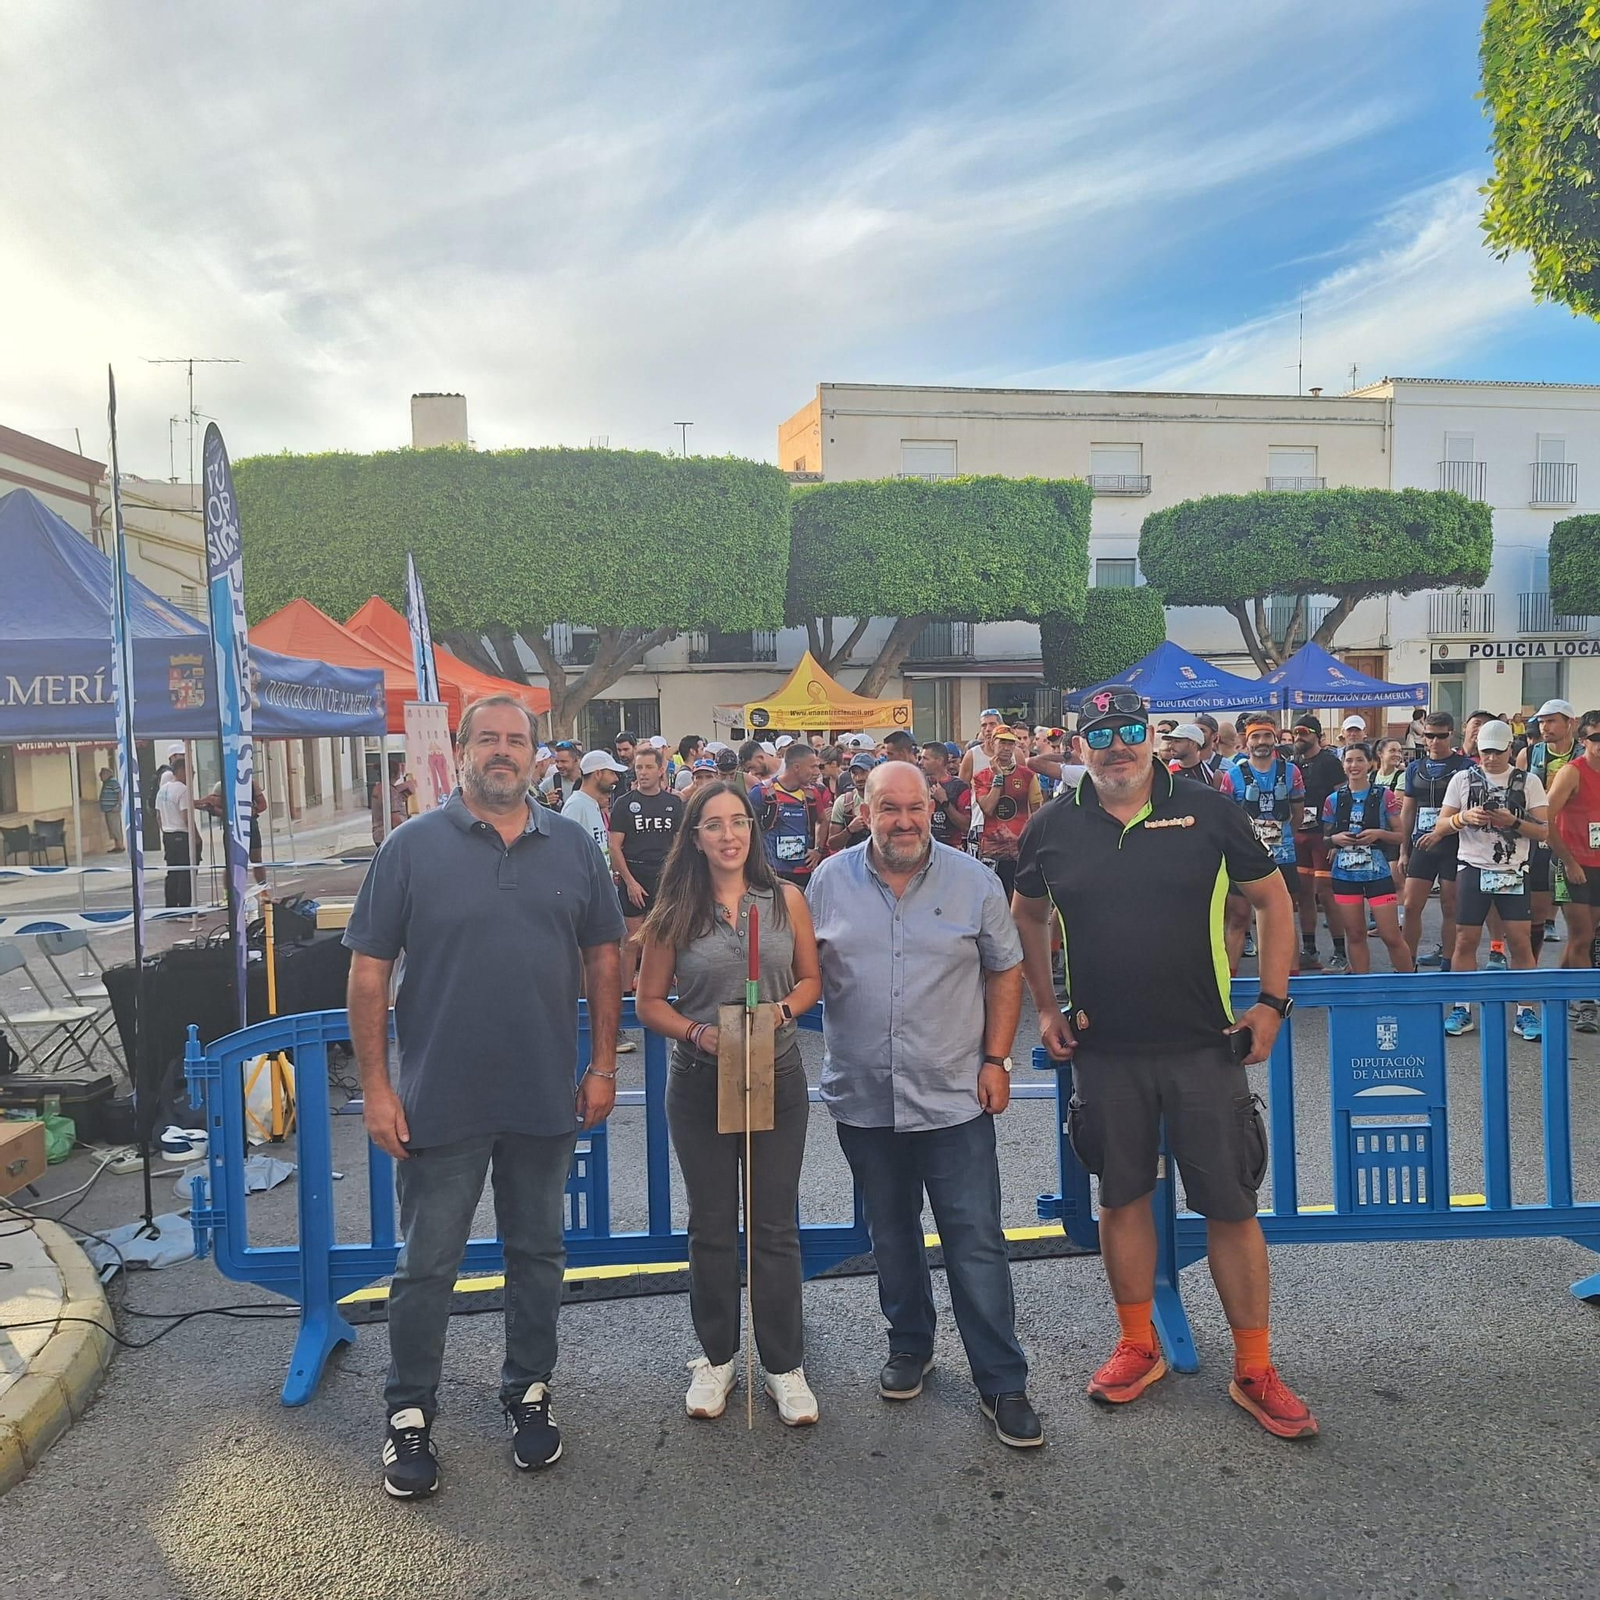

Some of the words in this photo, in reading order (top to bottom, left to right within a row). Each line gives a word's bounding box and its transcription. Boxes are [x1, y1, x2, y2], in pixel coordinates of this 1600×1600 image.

[1469, 642, 1547, 658] POLICIA
[0, 666, 137, 705] MERÍ
[265, 679, 327, 711] DIPUTACIÓN
[327, 688, 339, 713] DE
[1156, 695, 1210, 708] DIPUTACIÓN
[1213, 698, 1225, 706] DE
[1226, 694, 1264, 705] ALMERÍA
[1308, 692, 1359, 702] DIPUTACIÓN
[1361, 693, 1372, 701] DE
[1373, 691, 1411, 701] ALMERÍA
[1351, 1055, 1425, 1068] DIPUTACIÓN
[1353, 1070, 1368, 1080] DE
[1372, 1067, 1424, 1079] ALMERÍA
